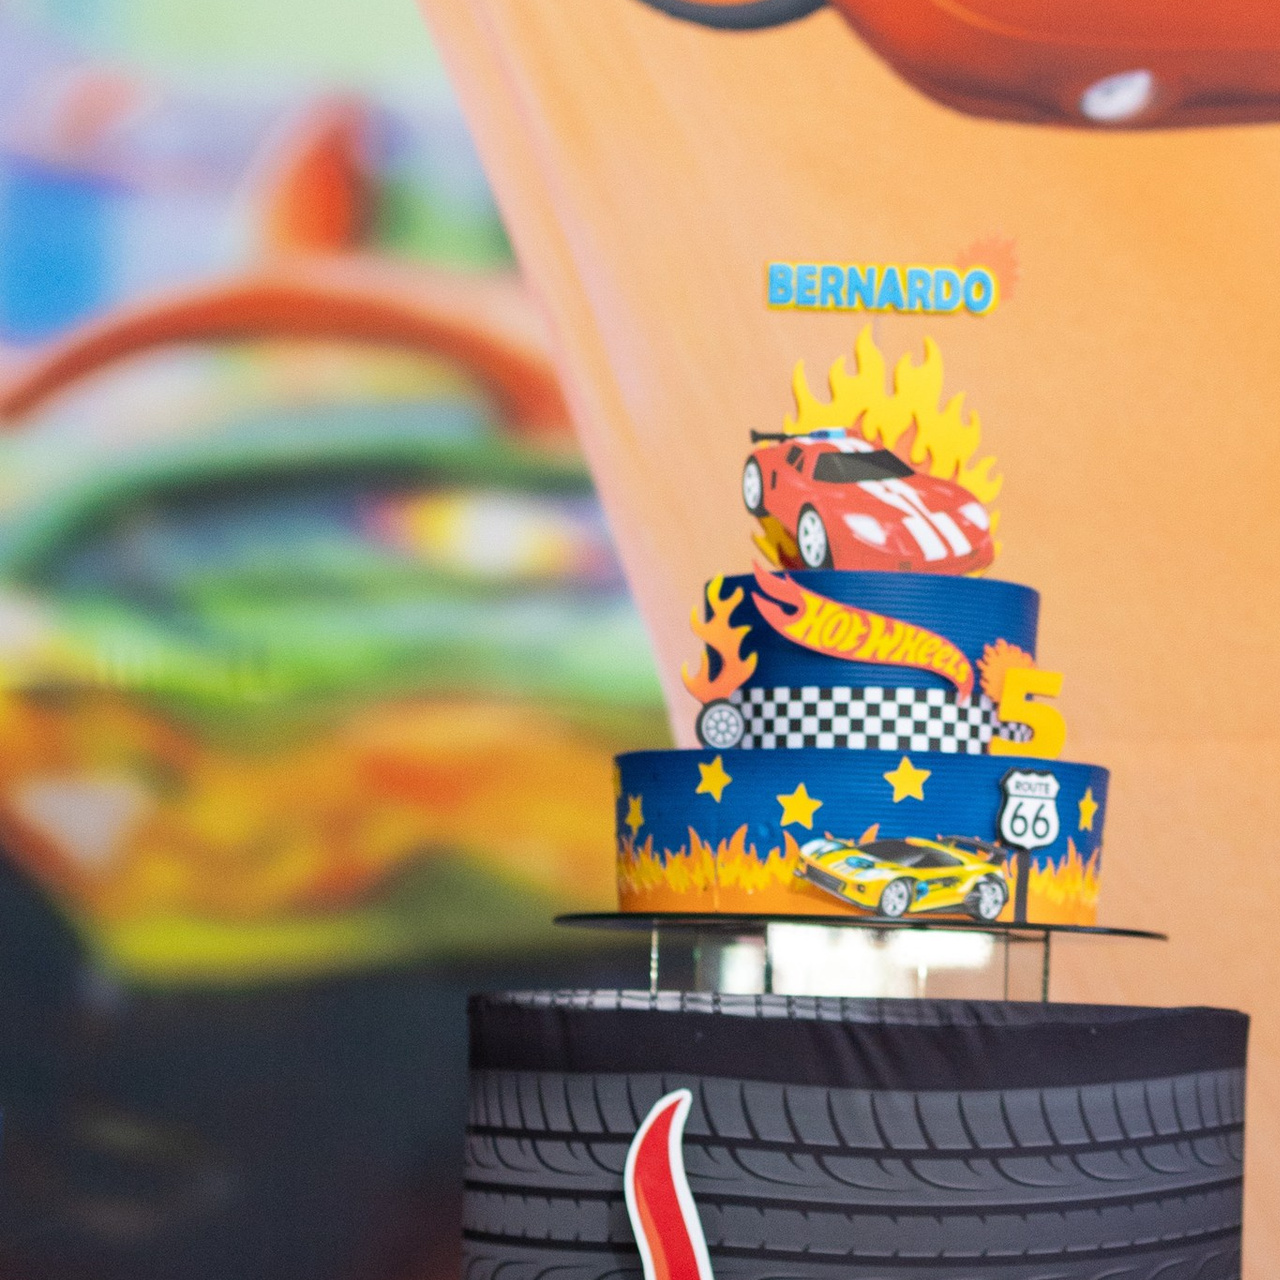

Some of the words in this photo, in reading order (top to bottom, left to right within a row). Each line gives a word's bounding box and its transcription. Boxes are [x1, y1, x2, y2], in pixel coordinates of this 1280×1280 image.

[766, 262, 996, 315] BERNARDO
[784, 591, 868, 652] HOT
[988, 666, 1067, 759] 5
[1014, 780, 1051, 795] ROUTE
[1010, 801, 1050, 839] 66
